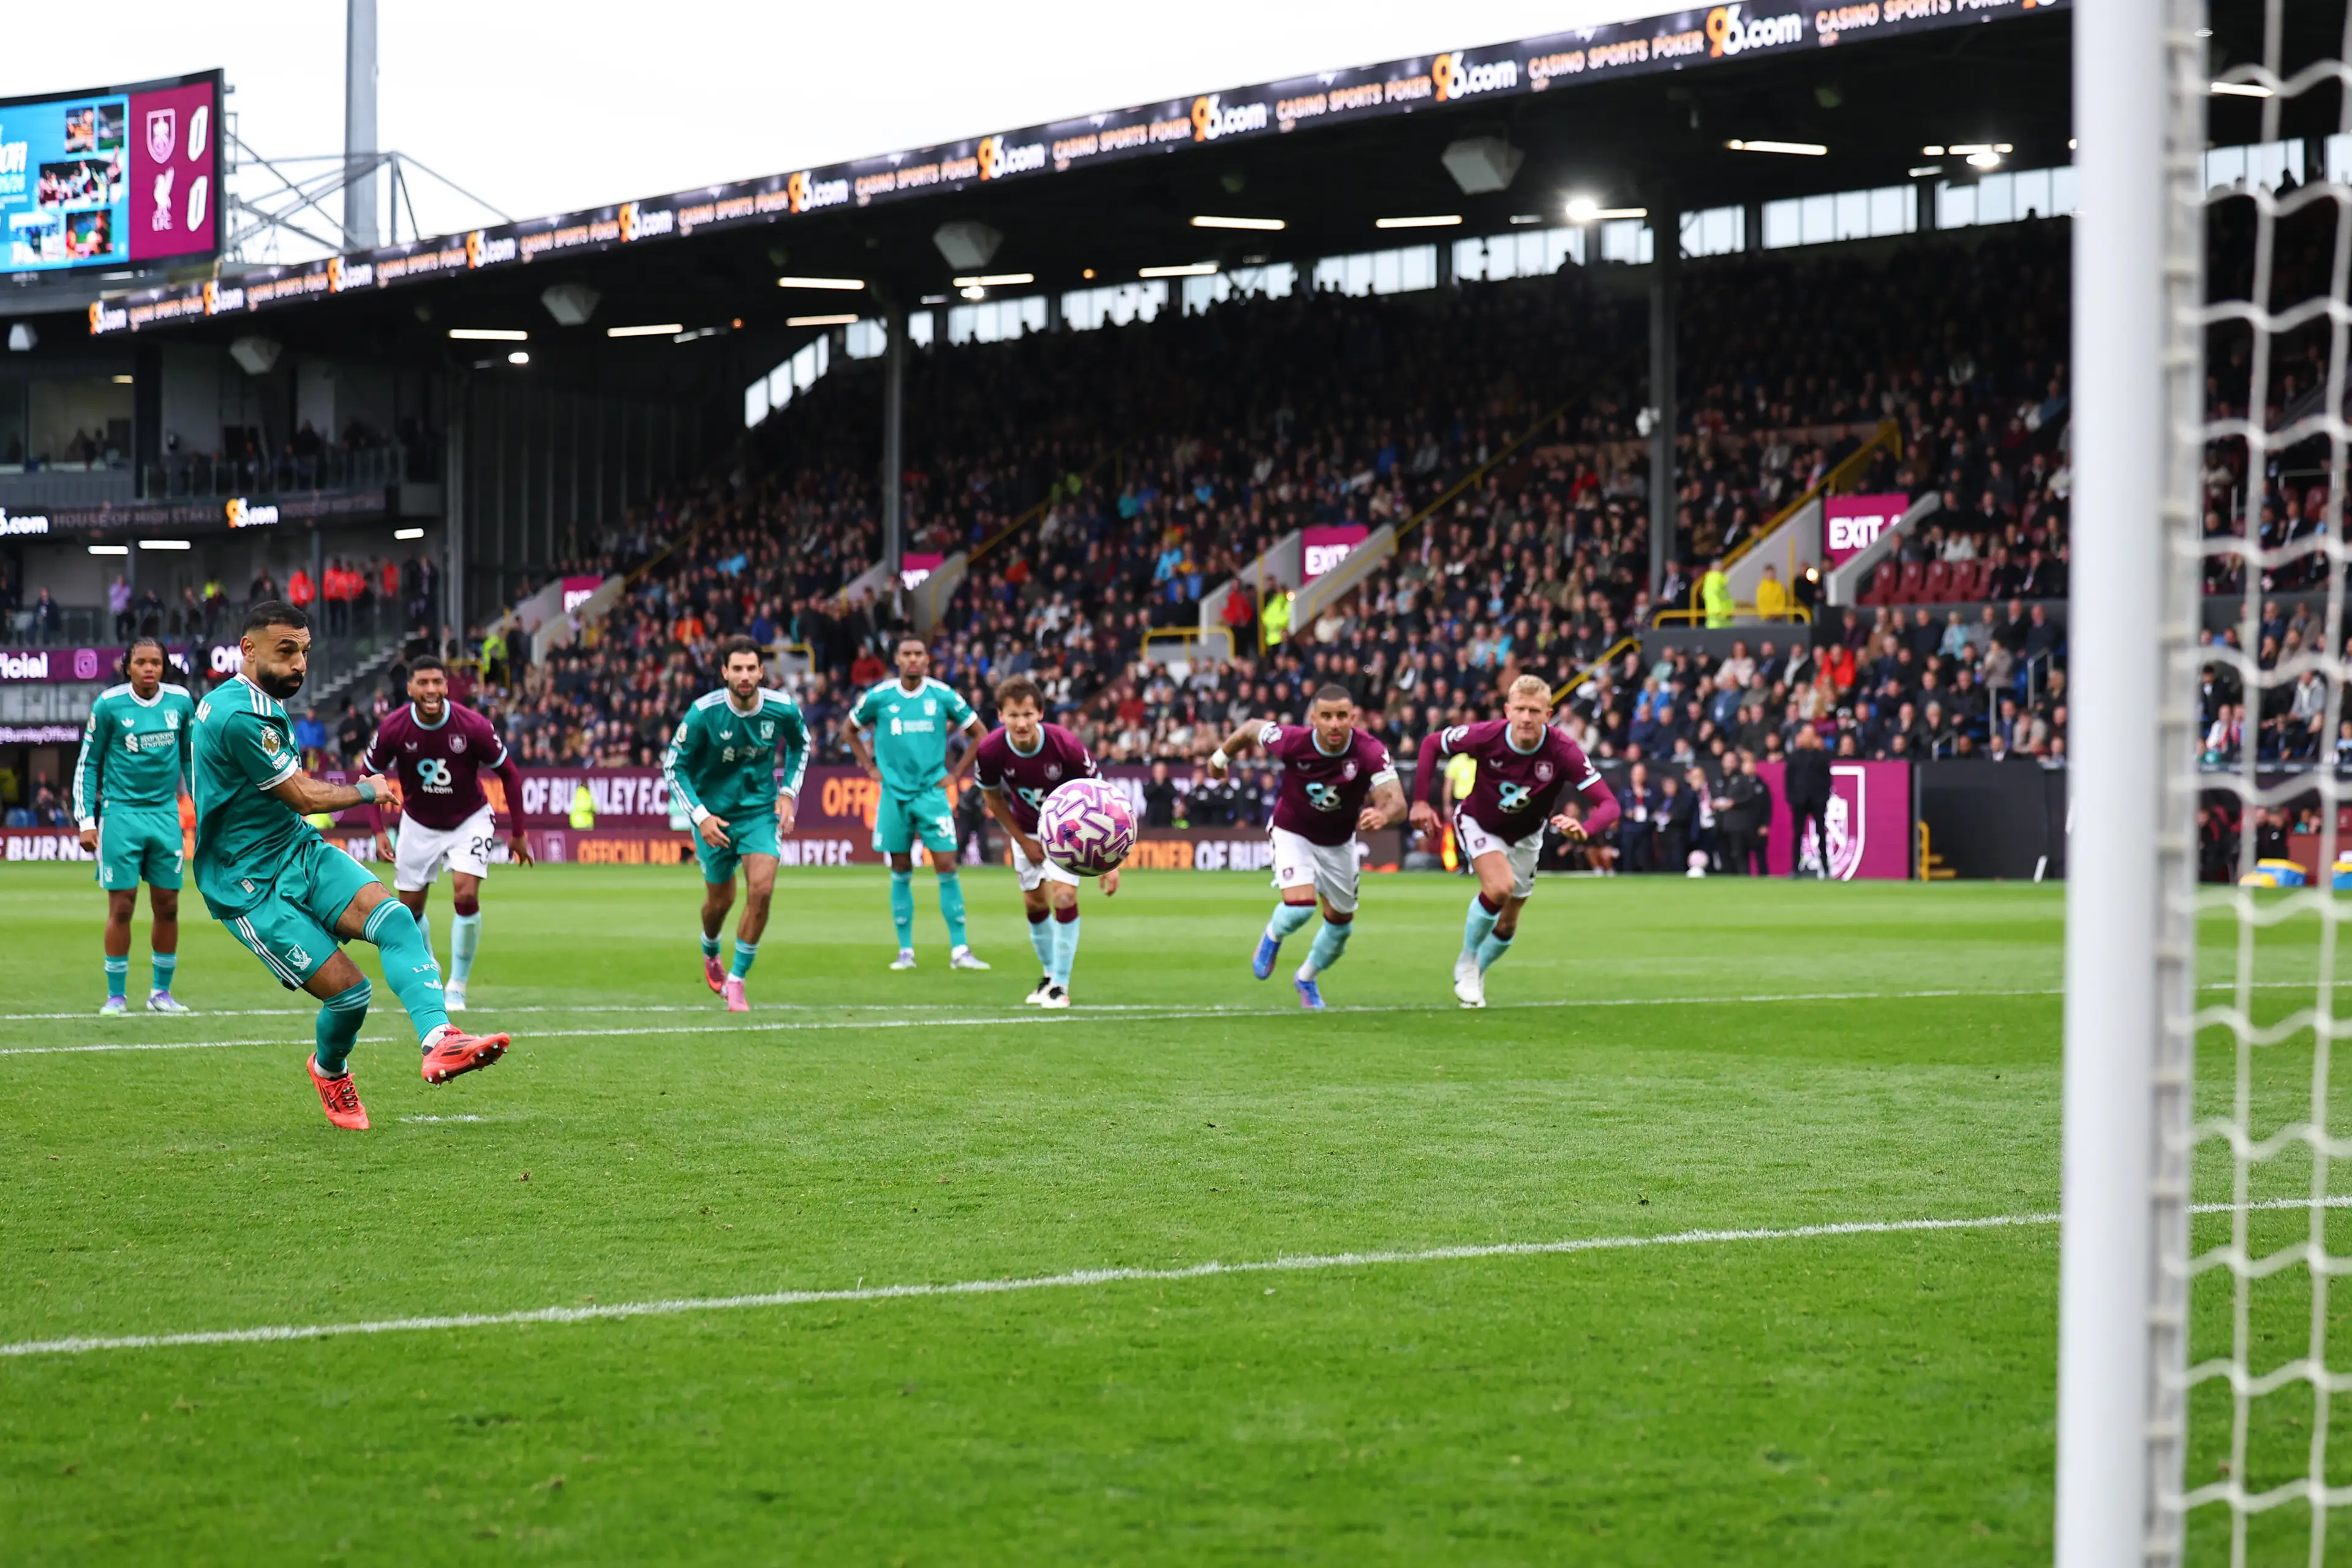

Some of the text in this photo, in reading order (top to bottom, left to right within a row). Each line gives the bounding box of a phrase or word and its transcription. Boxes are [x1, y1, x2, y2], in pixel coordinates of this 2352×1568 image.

[1706, 3, 1803, 58] 96.com
[1815, 2, 1879, 34] CASINO
[1431, 51, 1517, 102] 96.com
[1528, 50, 1585, 80] CASINO
[1588, 39, 1649, 69] SPORTS
[1651, 30, 1705, 59] POKER
[1191, 93, 1267, 142] 96.com
[1276, 94, 1327, 123] CASINO
[1329, 83, 1383, 112] SPORTS
[1384, 75, 1432, 104] POKER
[187, 105, 208, 162] 0
[977, 134, 1046, 181] 96.com
[1052, 134, 1098, 161] CASINO
[1099, 124, 1148, 152] SPORTS
[1148, 116, 1191, 144] POKER
[187, 175, 208, 232] 0
[788, 170, 849, 214] 96.com
[1829, 515, 1885, 549] EXIT
[0, 651, 48, 679] icial
[140, 731, 175, 743] standard
[140, 737, 175, 749] chartered
[417, 758, 452, 786] 96
[421, 784, 453, 794] 96.com
[521, 777, 549, 815] OF
[549, 777, 638, 815] BUNLEY
[1195, 840, 1227, 870] OF
[412, 963, 439, 973] LFC
